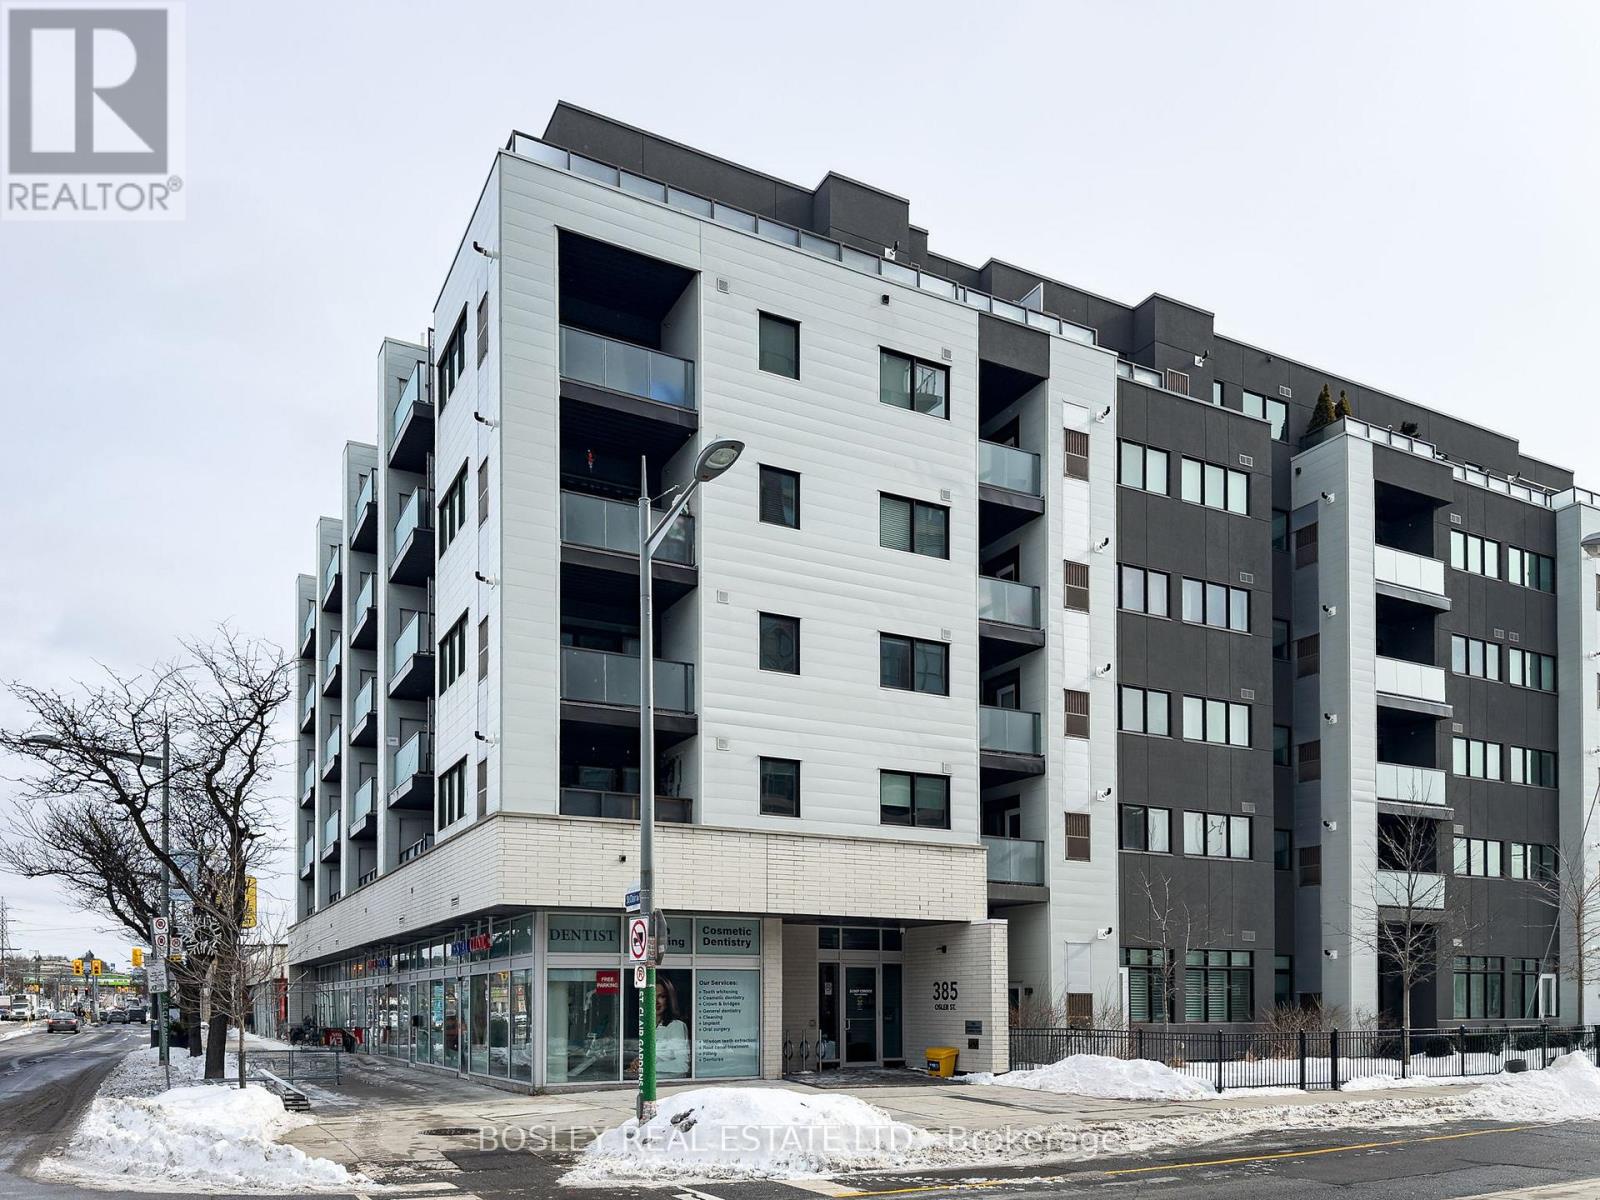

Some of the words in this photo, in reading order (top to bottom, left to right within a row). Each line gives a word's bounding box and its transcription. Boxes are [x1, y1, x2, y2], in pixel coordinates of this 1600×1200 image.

[550, 928, 616, 941] DENTIST
[702, 926, 752, 936] Cosmetic
[702, 938, 752, 949] Dentistry
[932, 981, 958, 1001] 385
[934, 1003, 949, 1011] OSLER
